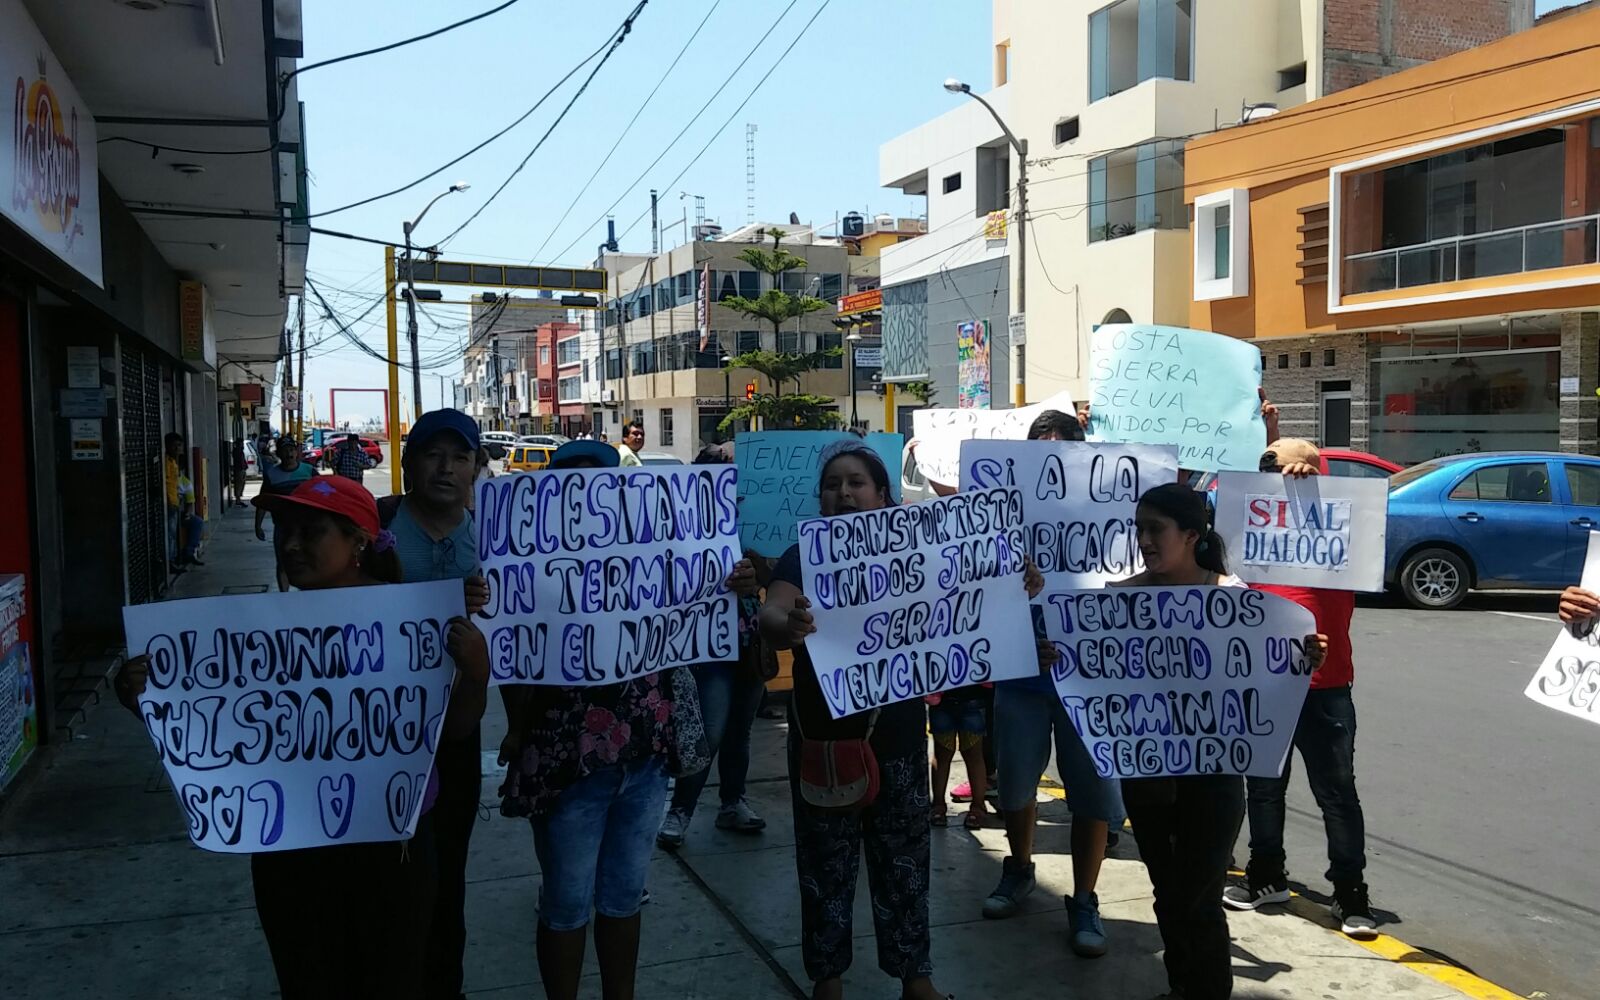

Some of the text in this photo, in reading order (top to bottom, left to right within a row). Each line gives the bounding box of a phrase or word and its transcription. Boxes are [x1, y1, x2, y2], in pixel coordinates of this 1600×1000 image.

[34, 84, 81, 234] Royal
[1093, 358, 1198, 386] SIERRA
[1092, 386, 1184, 412] SELVA
[1182, 416, 1233, 437] POR
[738, 437, 826, 470] TENEM
[741, 476, 821, 498] DEREC
[1036, 454, 1067, 500] A
[1090, 455, 1139, 503] LA
[776, 498, 812, 516] AL
[1248, 499, 1344, 531] SI AL
[737, 521, 798, 542] TRAB
[1023, 518, 1147, 576] BiCACi
[1244, 531, 1344, 566] DIALOGO
[938, 528, 1025, 589] JAMÁS
[857, 587, 984, 656] SERÁN
[1048, 589, 1265, 634] TENEMOS
[400, 618, 452, 671] EL
[491, 598, 731, 681] EN EL NORTE
[1052, 636, 1313, 682] DERECHO A UN
[1093, 737, 1252, 778] SEGURO
[182, 780, 284, 845] LAS
[318, 774, 355, 838] A
